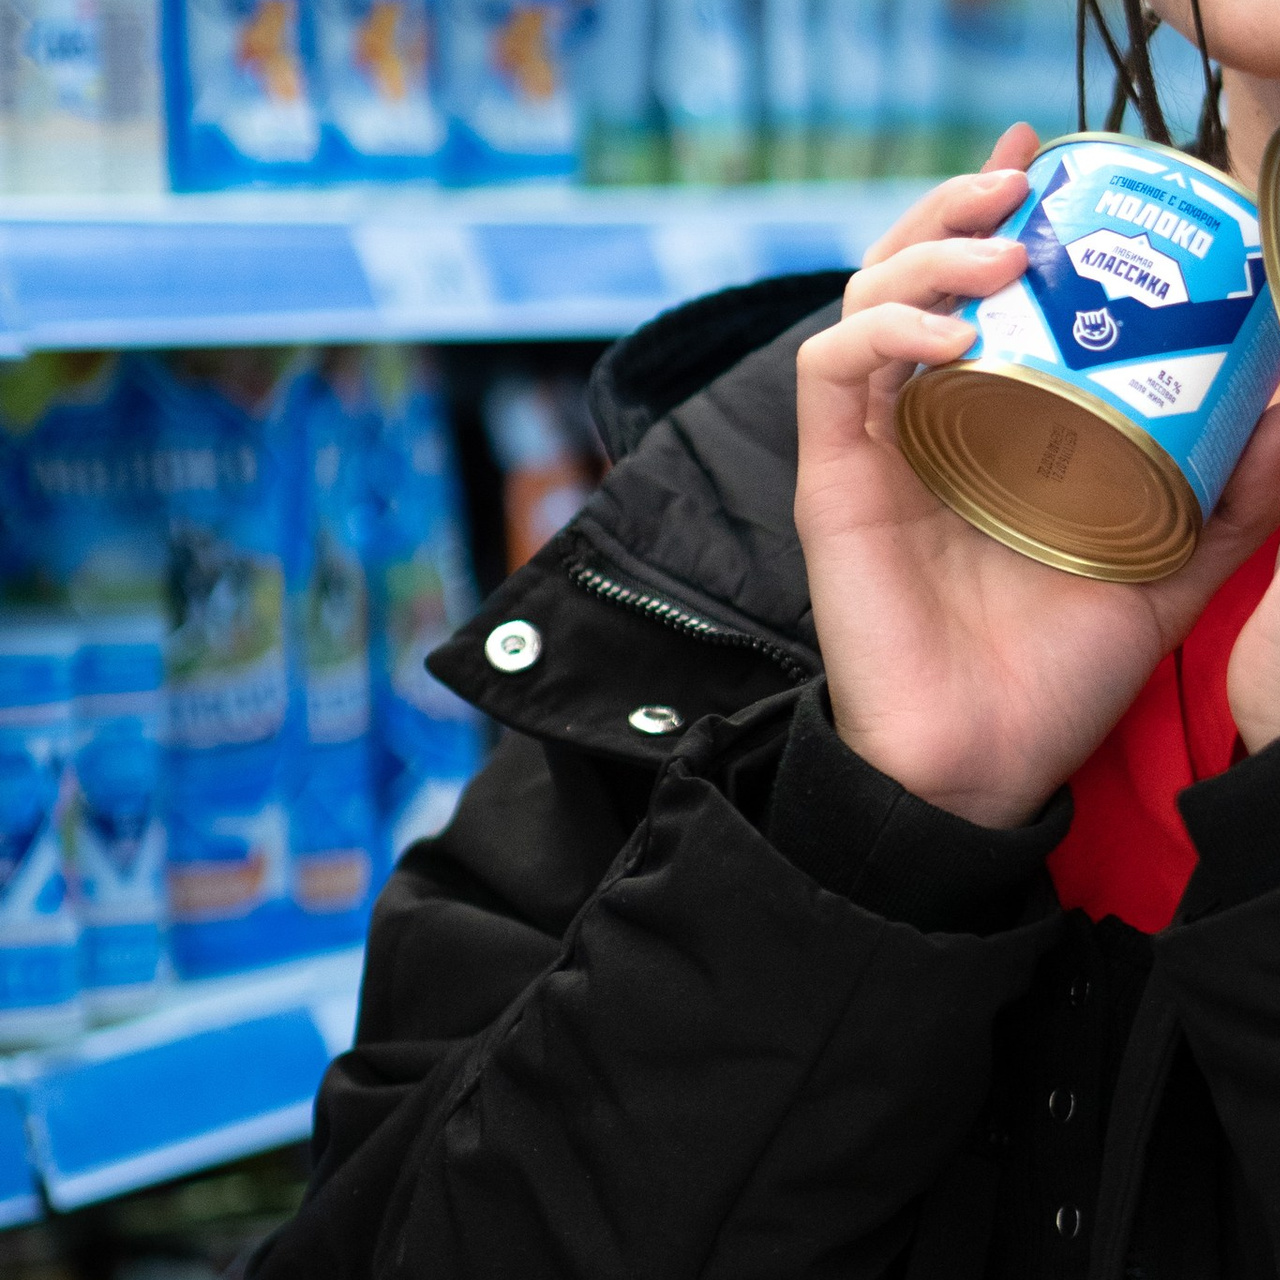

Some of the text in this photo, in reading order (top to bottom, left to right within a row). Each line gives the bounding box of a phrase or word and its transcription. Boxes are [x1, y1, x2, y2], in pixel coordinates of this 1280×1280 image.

[1095, 190, 1214, 260] МОЛОКО
[1109, 175, 1221, 232] СГУЩЕННОЕ С САХАРОМ
[1080, 248, 1171, 301] КЛАССИКА
[1112, 245, 1154, 269] ЛЮБИМАЯ
